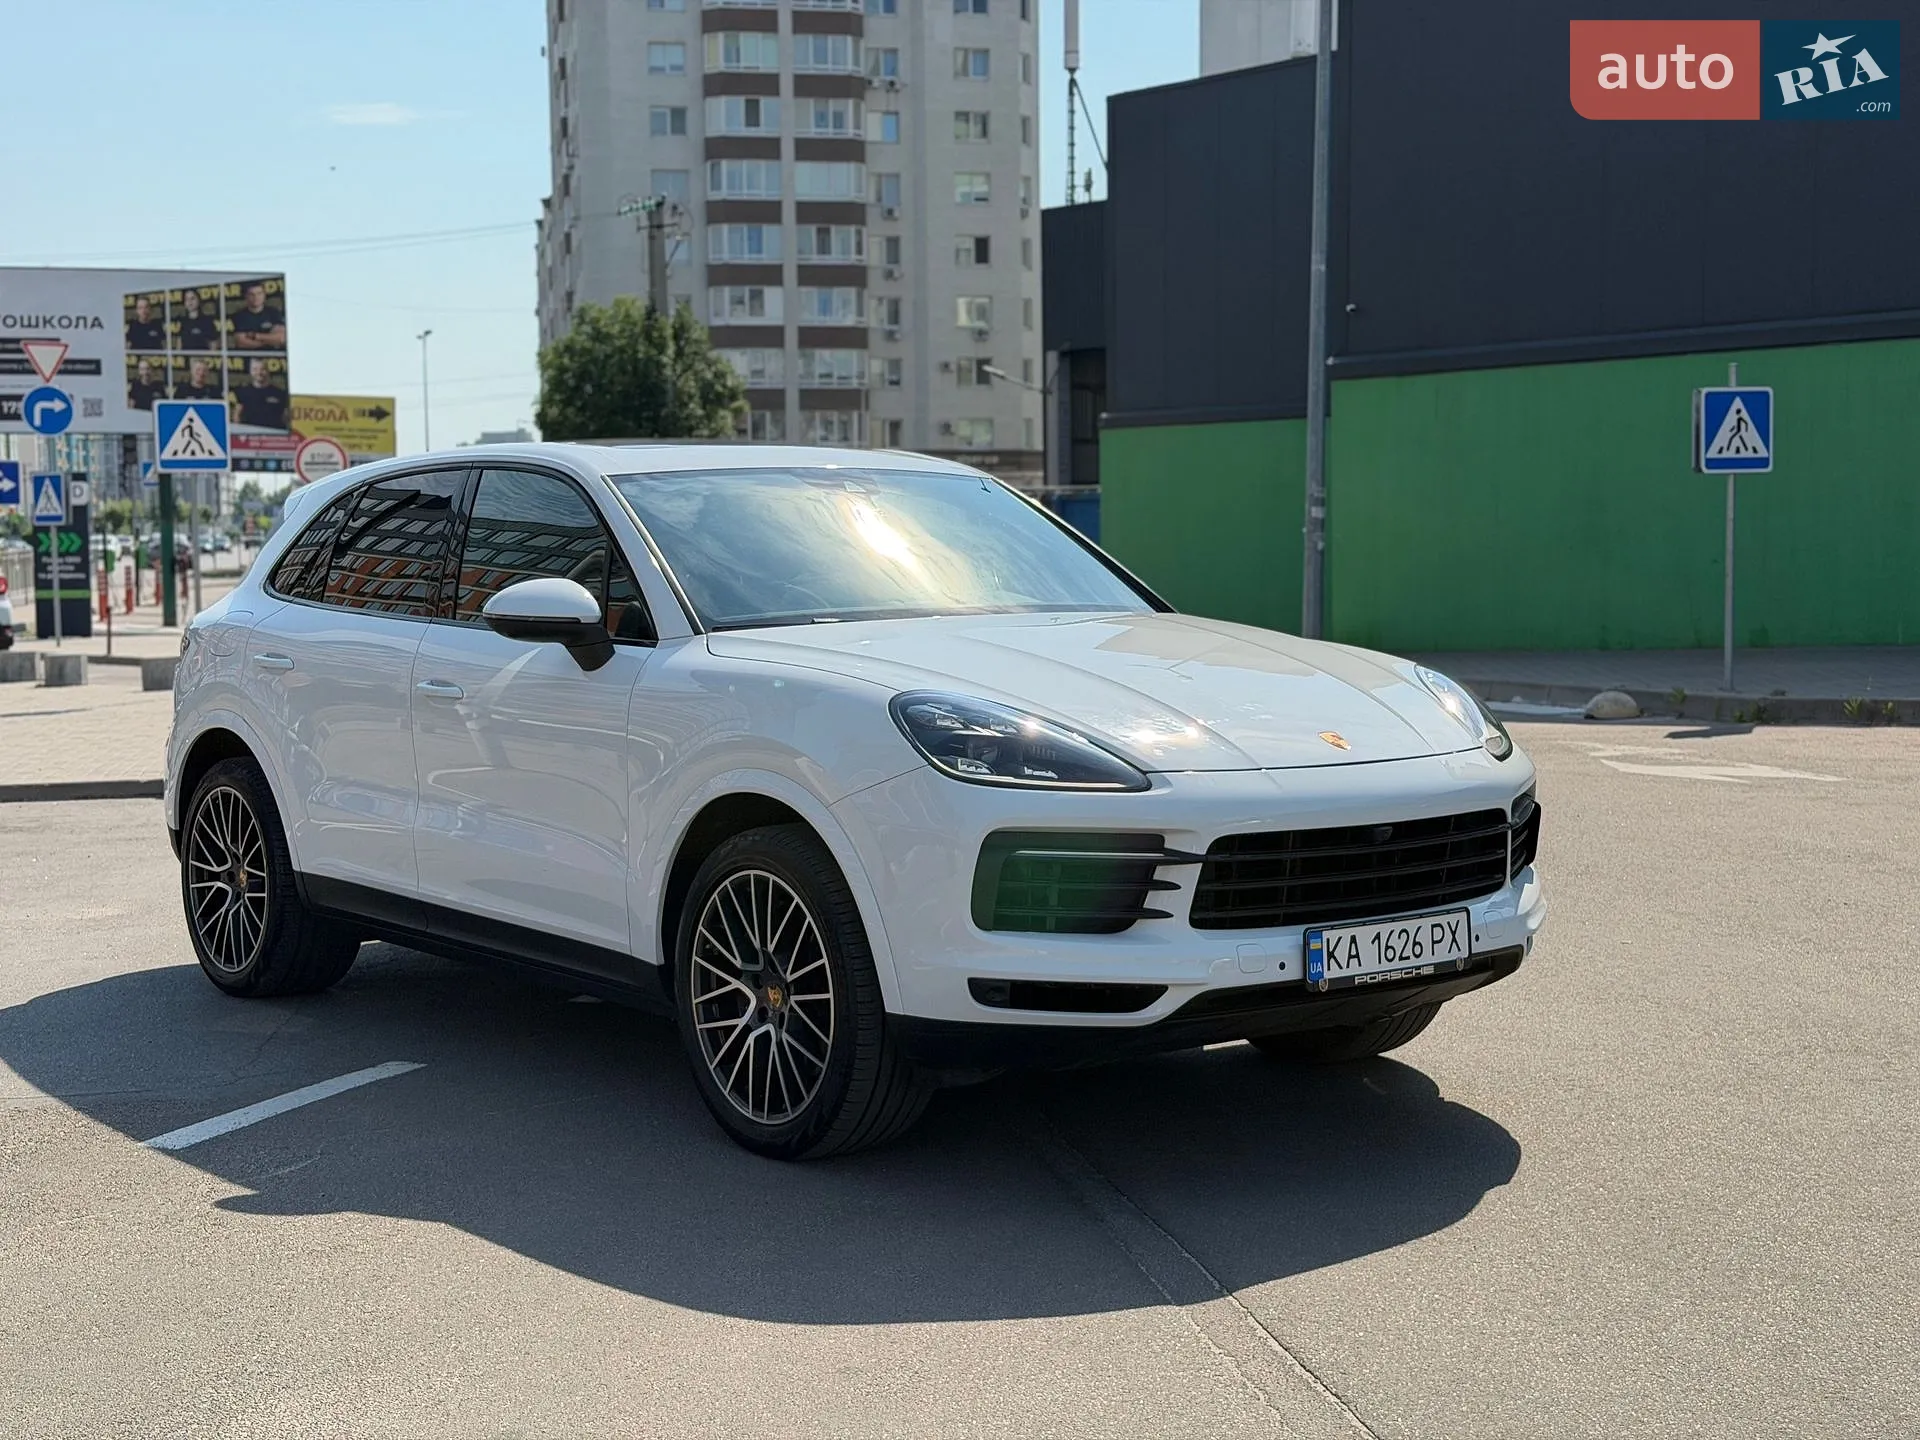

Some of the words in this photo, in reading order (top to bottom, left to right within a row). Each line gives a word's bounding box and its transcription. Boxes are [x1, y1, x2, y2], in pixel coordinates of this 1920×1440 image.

[0, 314, 105, 330] ОШКОЛА
[1326, 934, 1362, 971] KA
[1370, 925, 1424, 965] 1626
[1430, 919, 1462, 957] PX
[1310, 961, 1323, 975] UA
[1354, 965, 1436, 985] PORSCHE
